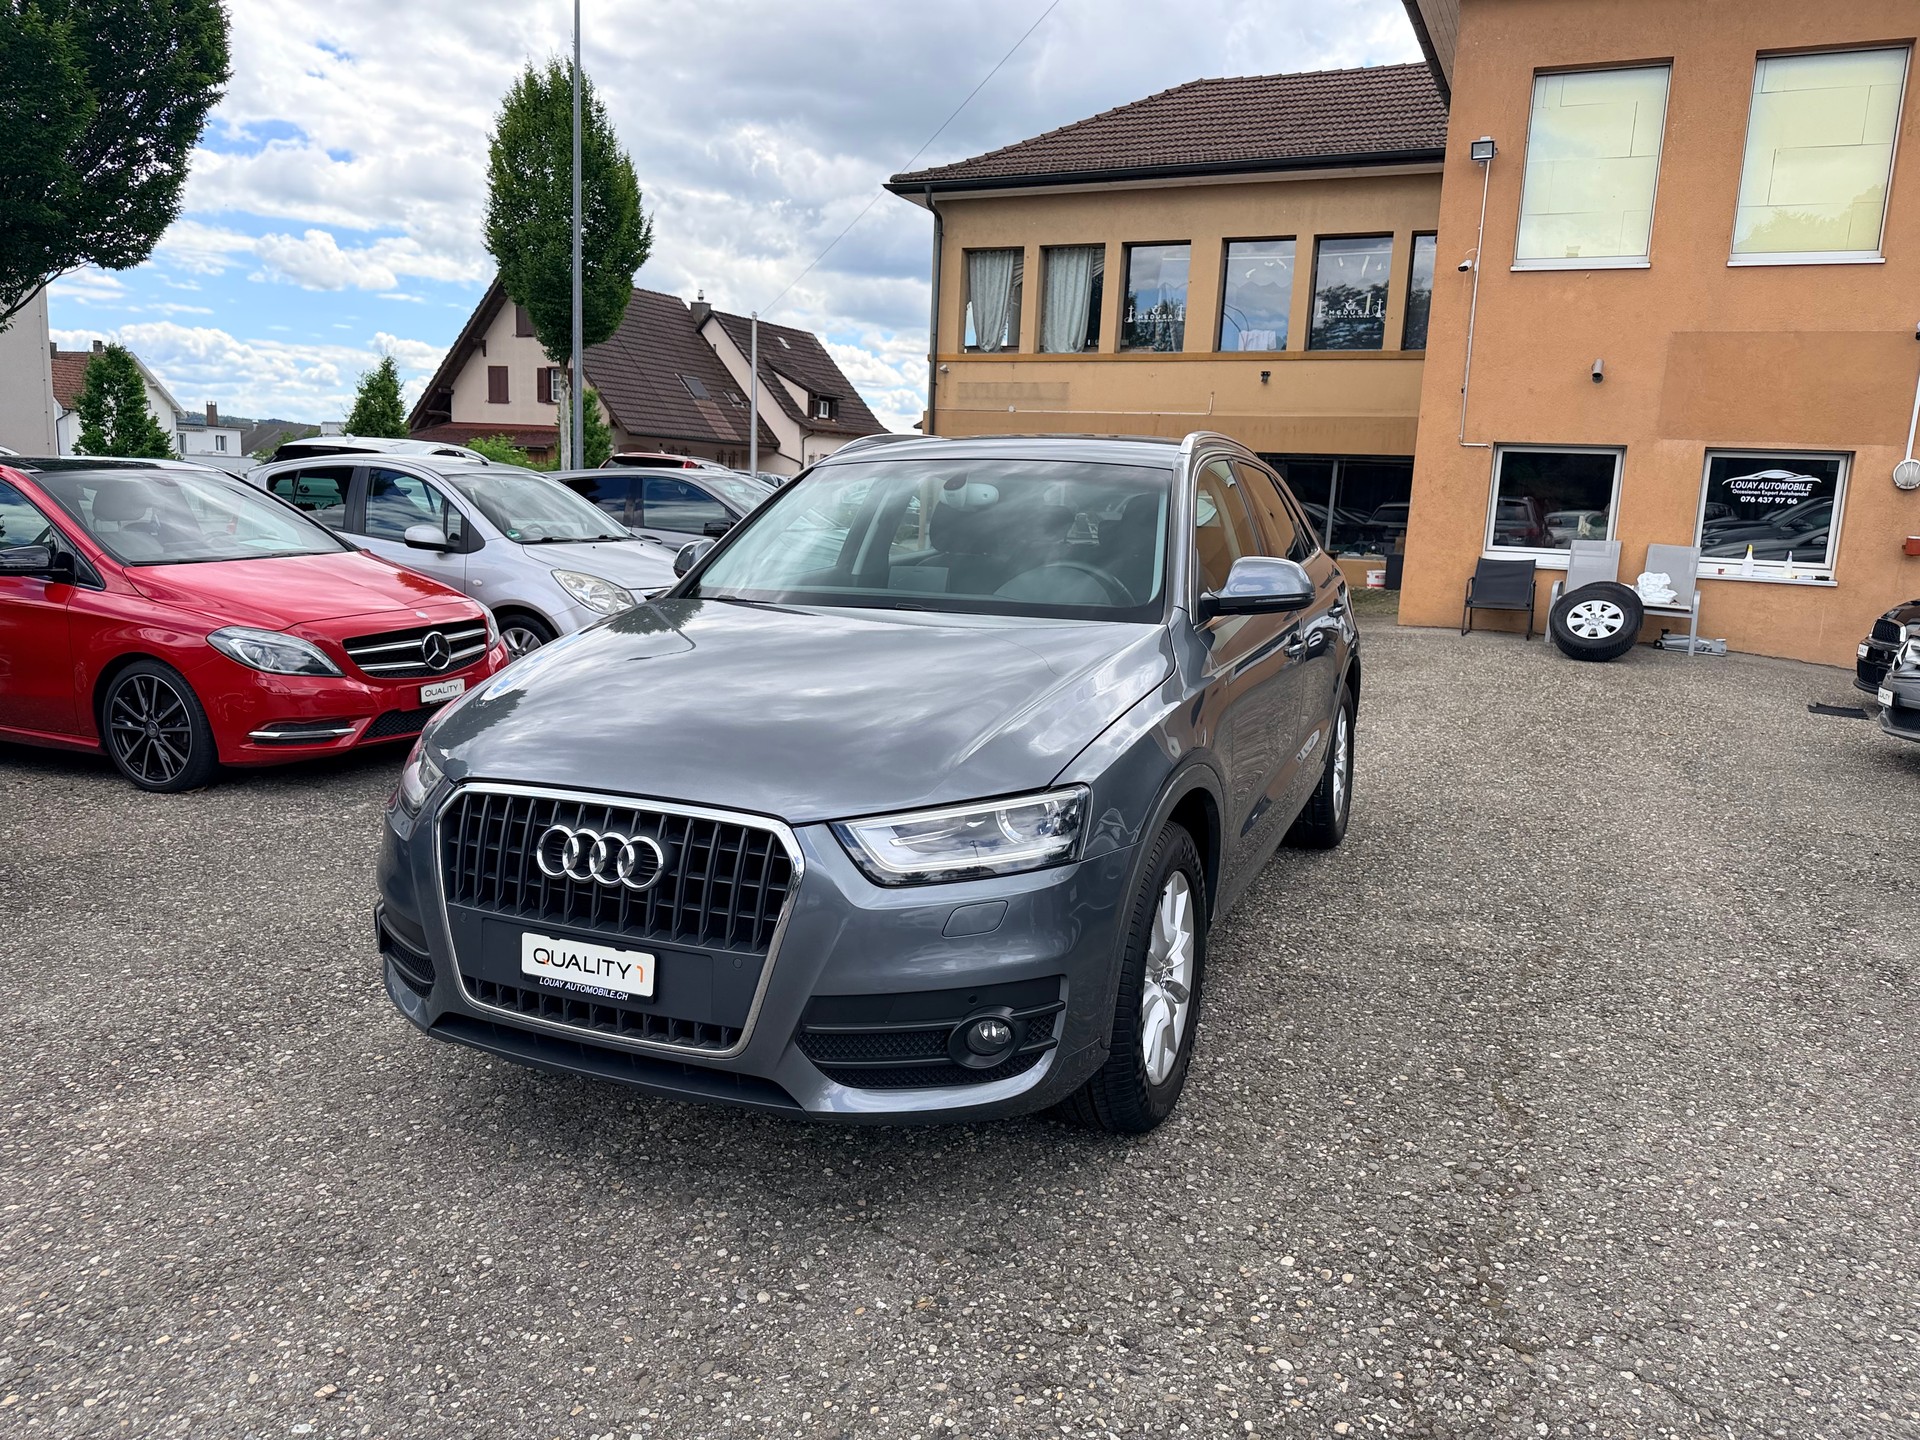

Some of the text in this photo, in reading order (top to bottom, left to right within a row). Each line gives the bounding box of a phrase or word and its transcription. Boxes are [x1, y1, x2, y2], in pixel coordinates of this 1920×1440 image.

[1730, 481, 1813, 491] LOUAY AUTOMOBILE
[1740, 496, 1756, 504] 076
[1757, 496, 1773, 504] 437
[1774, 497, 1786, 505] 97
[425, 684, 458, 697] QUALITY
[533, 947, 631, 980] QUALITY
[539, 977, 629, 1001] LOUAY AUTOMOBILE.CH
